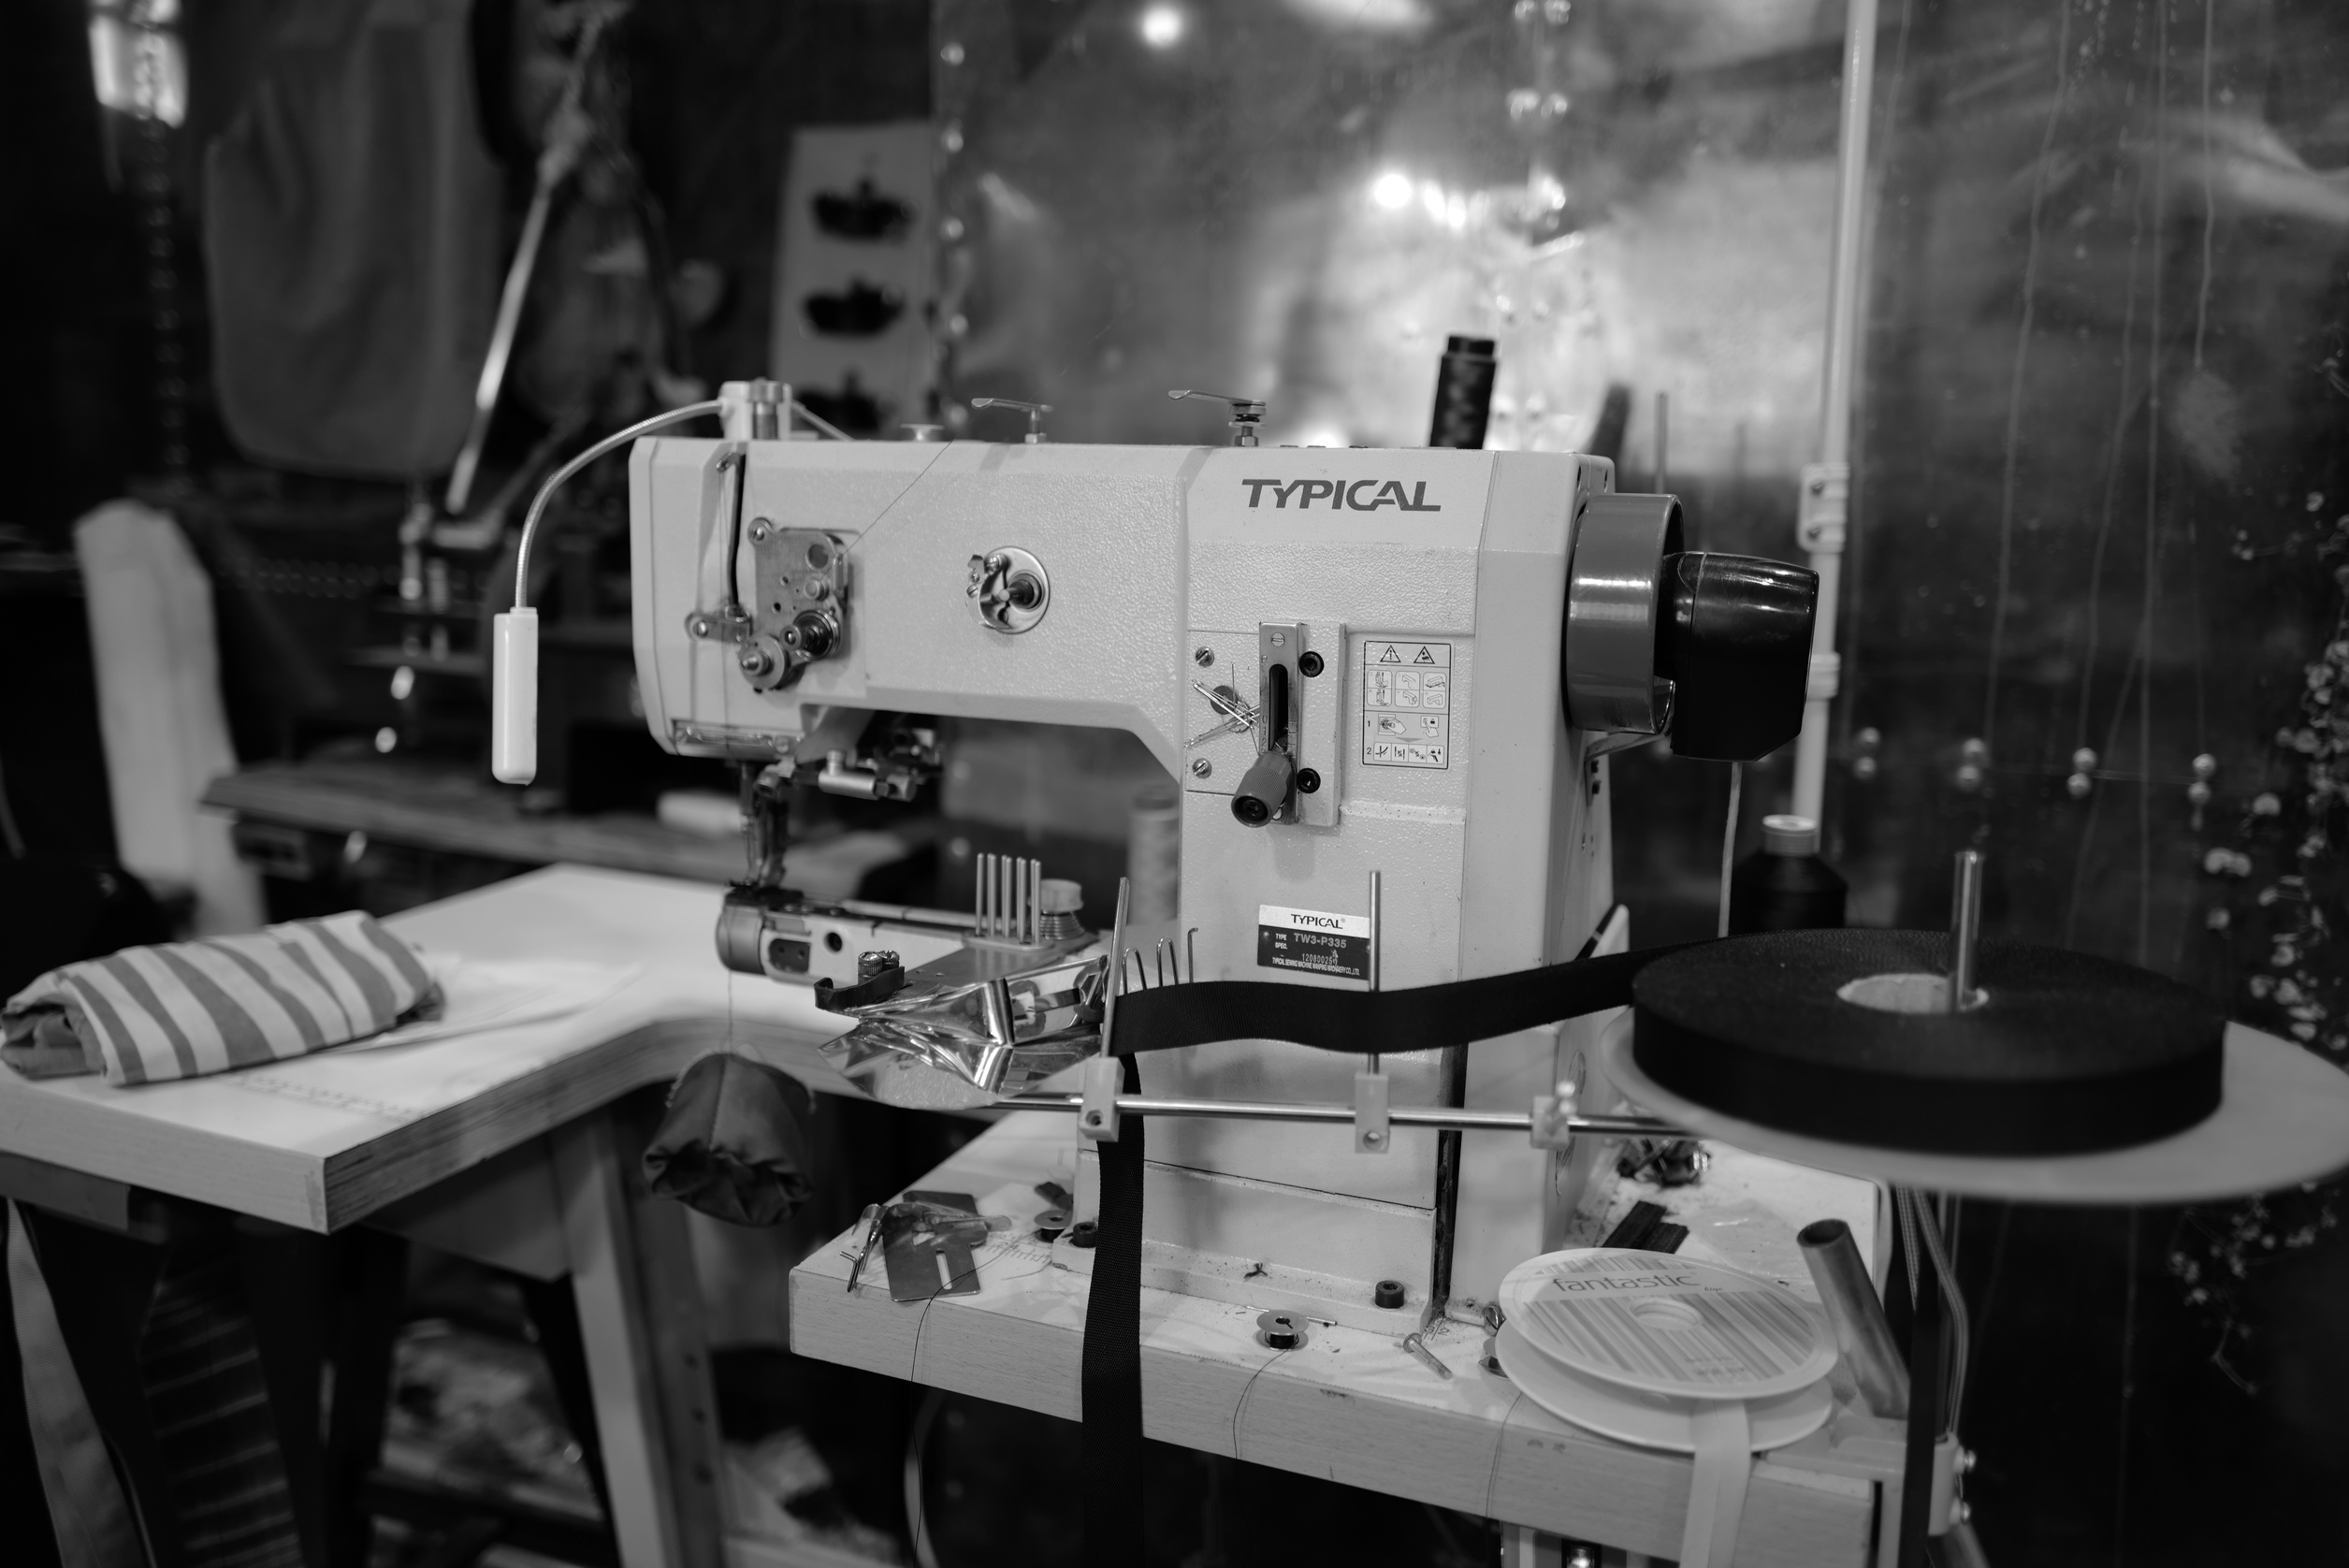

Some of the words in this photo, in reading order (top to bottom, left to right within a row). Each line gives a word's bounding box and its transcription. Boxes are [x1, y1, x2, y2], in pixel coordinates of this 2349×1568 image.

[1241, 478, 1442, 512] TYPICAL
[1291, 914, 1342, 929] TYPICAL
[1274, 942, 1288, 951] SPEC.
[1294, 932, 1347, 950] TW3-P335
[1552, 1274, 1701, 1292] fantastic
